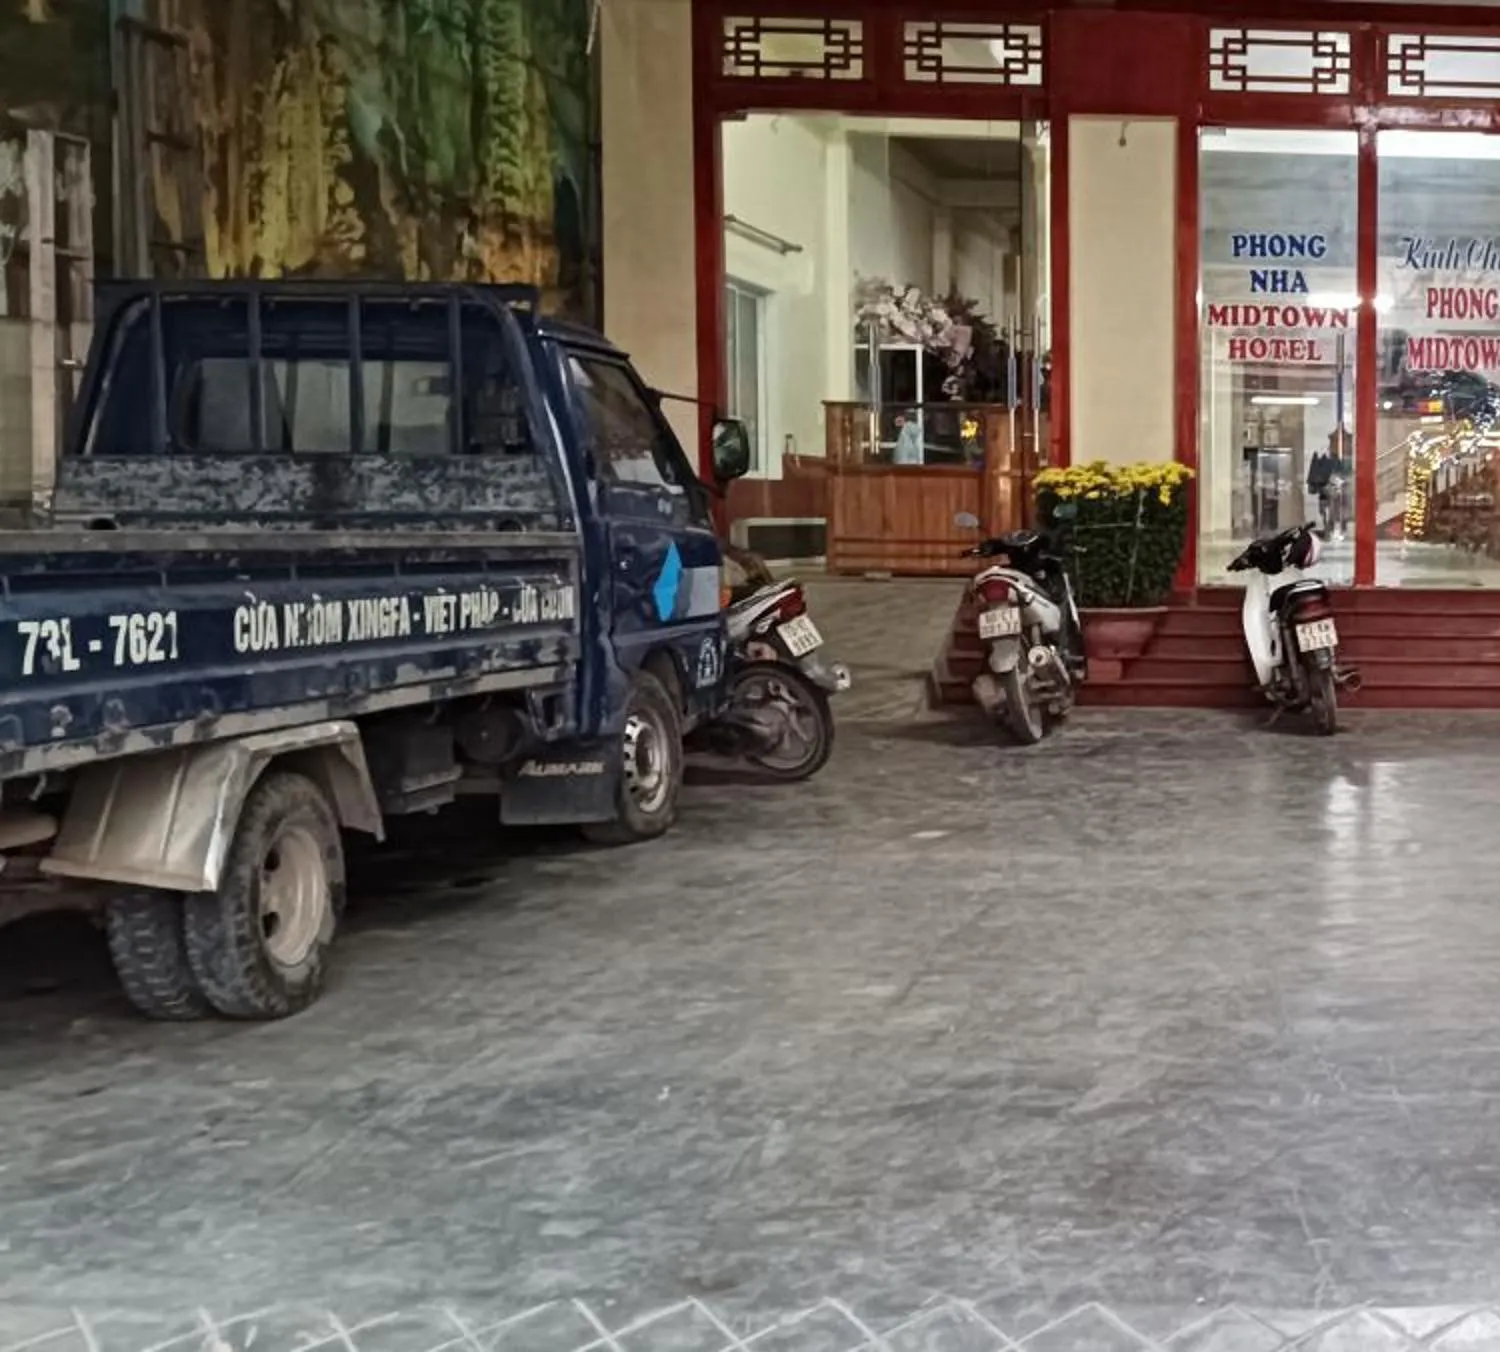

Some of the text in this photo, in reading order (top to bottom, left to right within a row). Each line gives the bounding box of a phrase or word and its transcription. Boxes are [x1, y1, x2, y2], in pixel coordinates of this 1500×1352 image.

[1231, 235, 1327, 258] PHONG
[1250, 270, 1309, 293] NHA
[1427, 288, 1499, 319] PHONG
[1208, 305, 1348, 328] MIDTOWN
[1228, 338, 1322, 361] HOTEL
[347, 596, 411, 642] XINGFA
[17, 617, 80, 675] 73L
[109, 611, 178, 666] 7621
